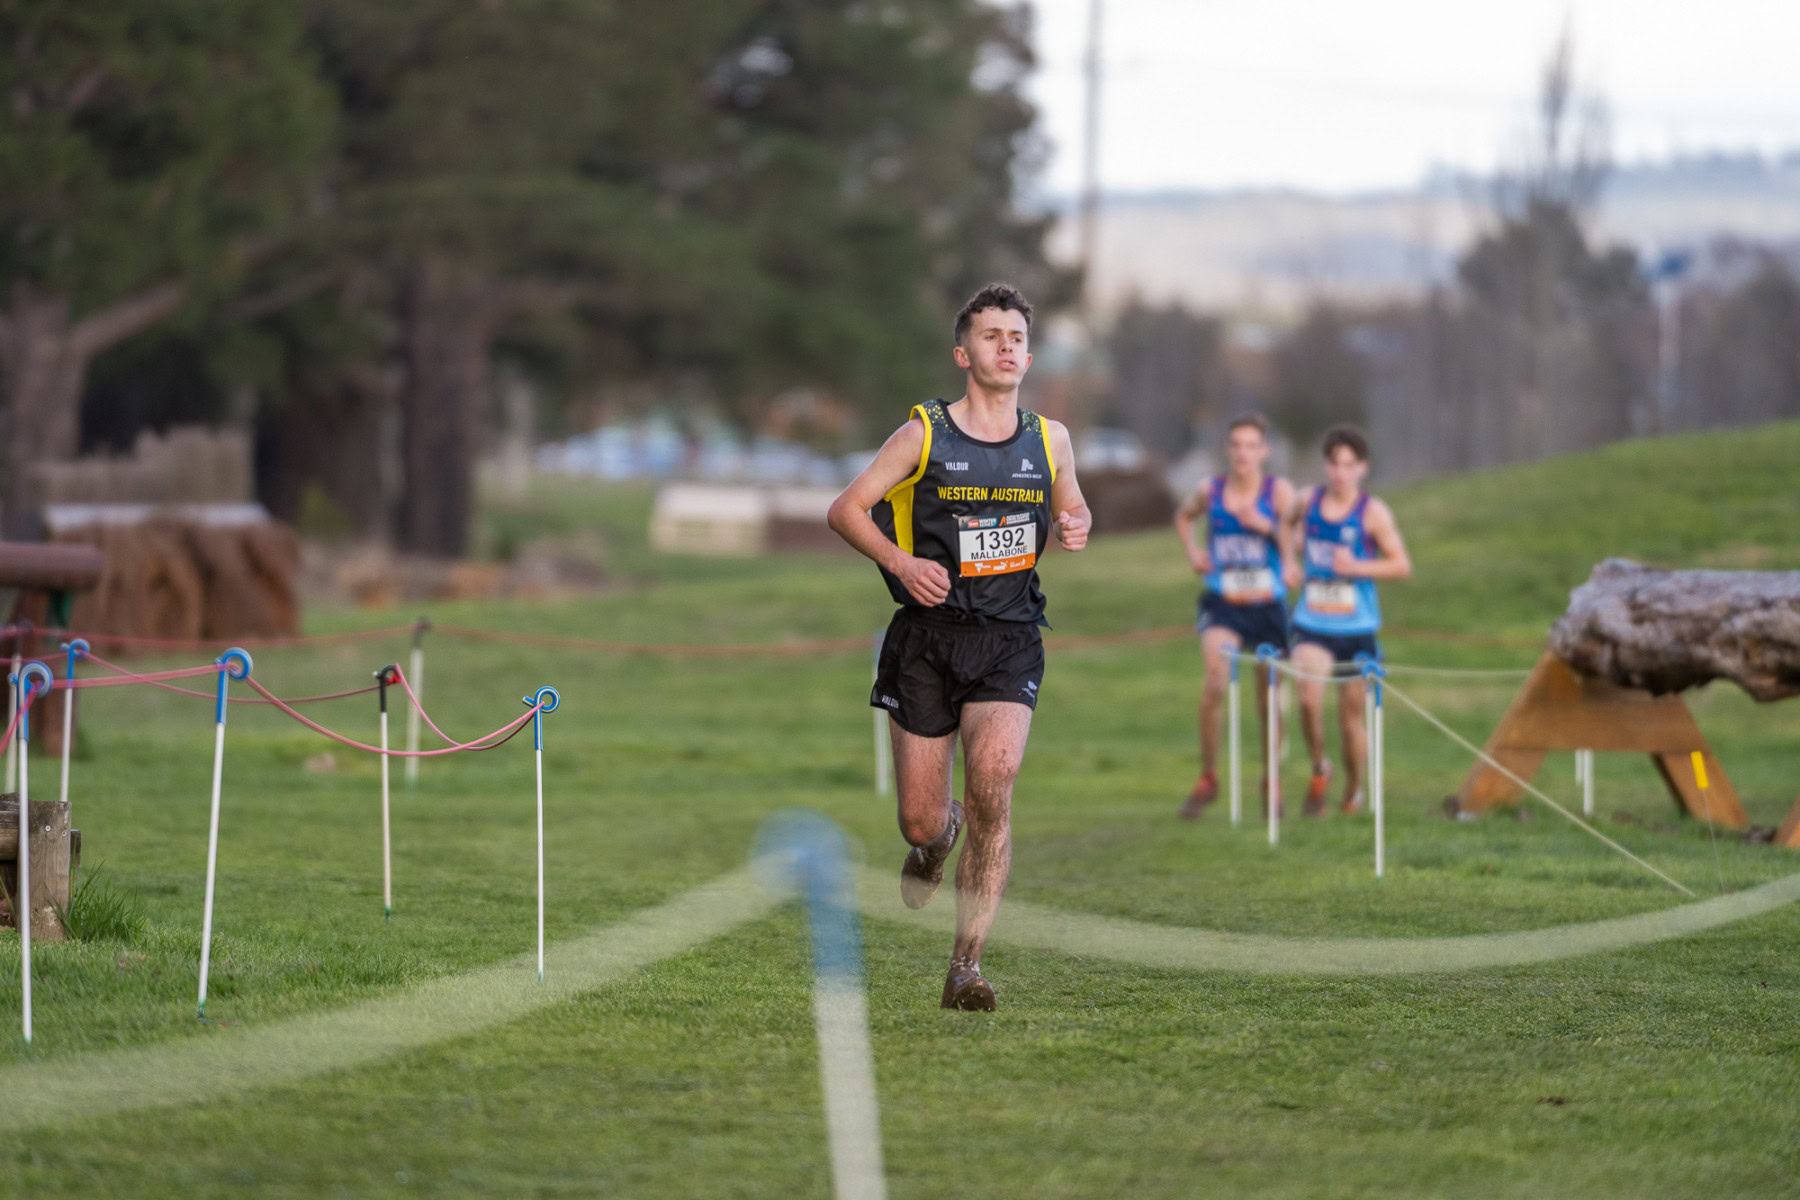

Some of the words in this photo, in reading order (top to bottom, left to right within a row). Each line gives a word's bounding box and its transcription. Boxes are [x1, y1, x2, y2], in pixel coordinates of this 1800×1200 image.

[938, 486, 988, 500] WESTERN
[991, 487, 1043, 503] AUSTRALIA
[976, 528, 1024, 550] 1392
[971, 546, 1027, 560] MALLABONE
